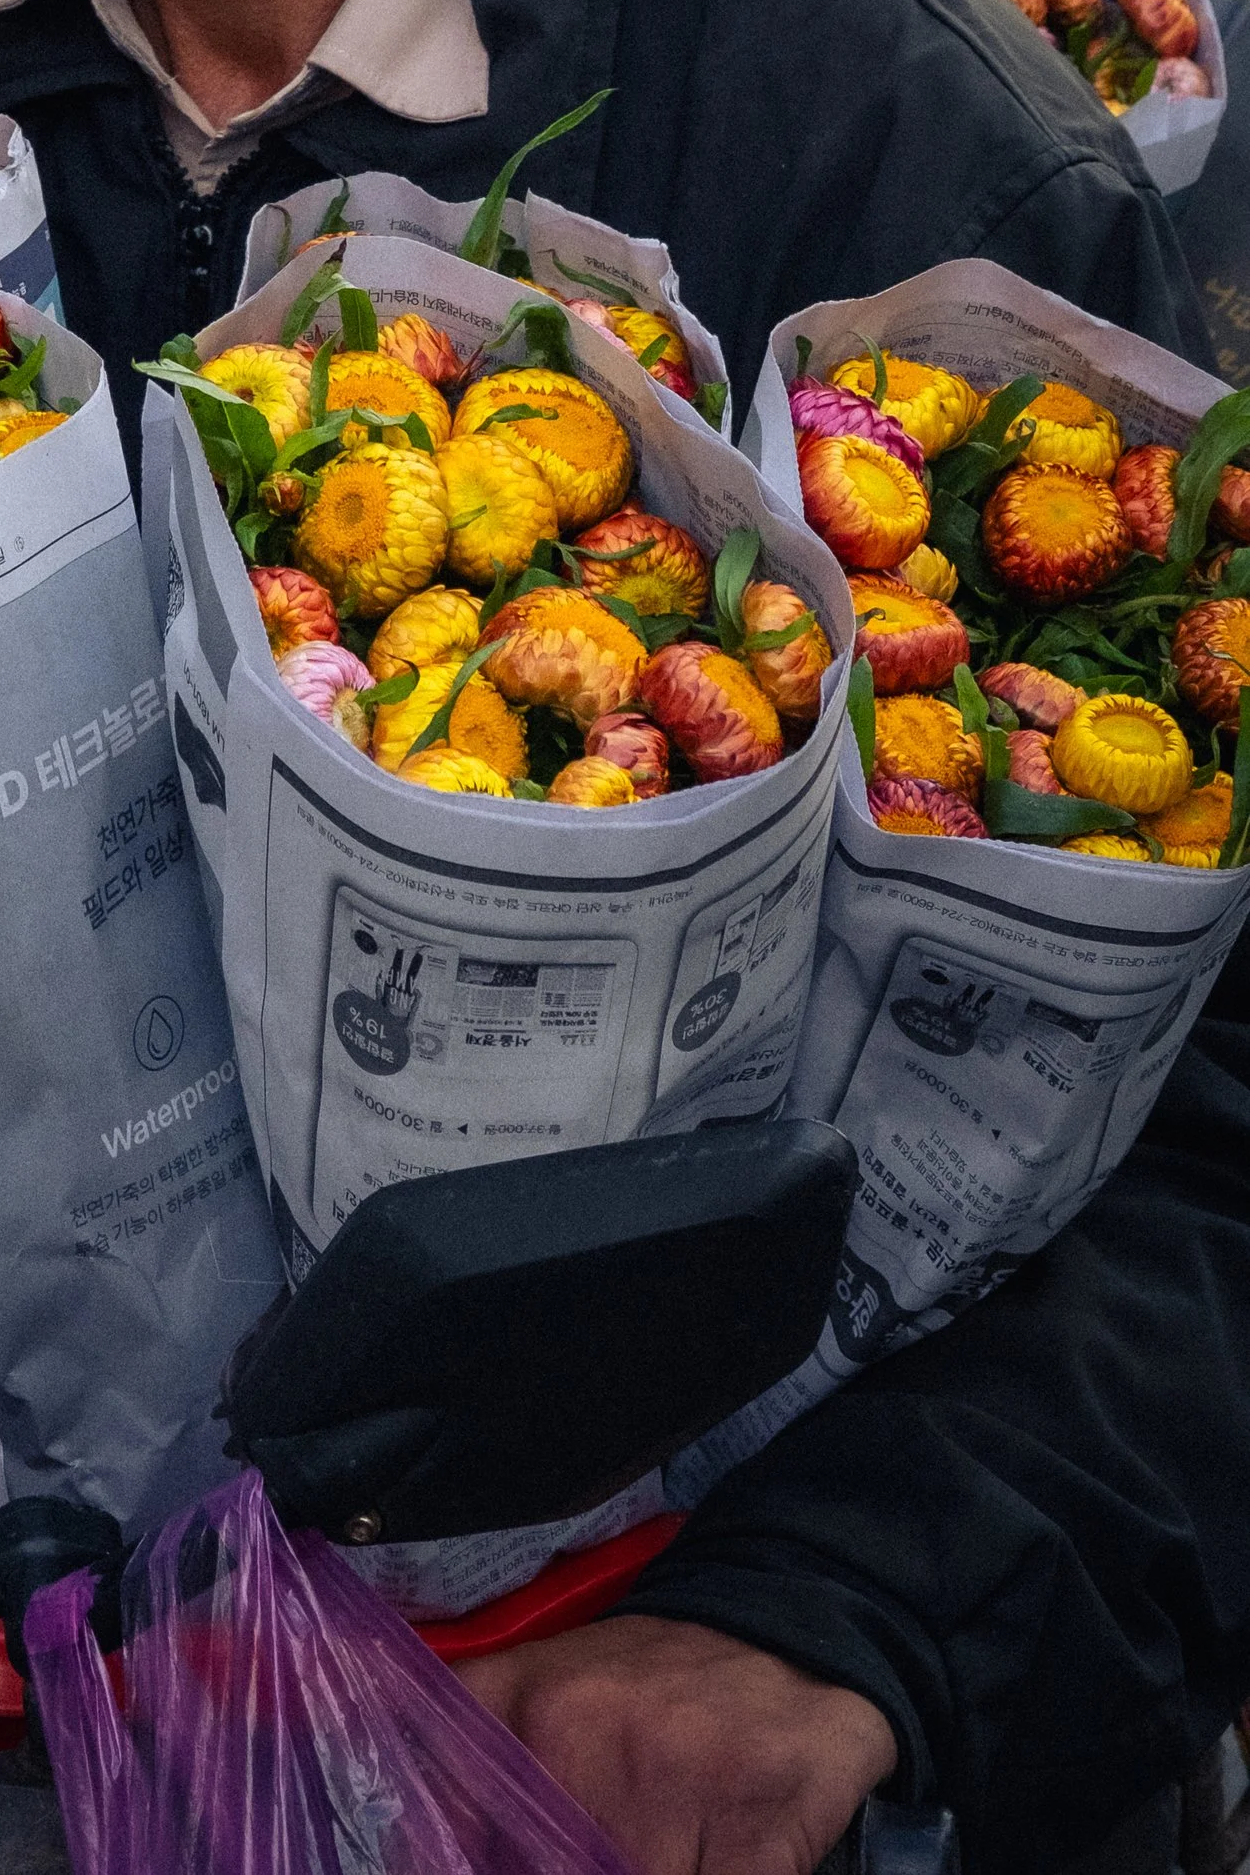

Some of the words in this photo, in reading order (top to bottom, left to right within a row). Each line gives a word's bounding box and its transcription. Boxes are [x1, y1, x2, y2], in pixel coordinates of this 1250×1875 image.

[367, 286, 420, 307] 없습니다
[34, 675, 166, 794] 테크놀로
[81, 855, 143, 931] 필드와
[525, 900, 573, 915] QR코드
[348, 1005, 388, 1042] 19%
[463, 1031, 534, 1050] 서울경제
[1021, 1049, 1075, 1095] 서울경제
[101, 1060, 236, 1159] Waterproo
[861, 1145, 907, 1201] 결합할인
[916, 1138, 963, 1192] 종이신문과
[921, 1129, 968, 1175] 있습니다.
[69, 1173, 156, 1229] 천연가죽의
[111, 1203, 165, 1241] 기능이
[165, 1169, 227, 1214] 하루종일
